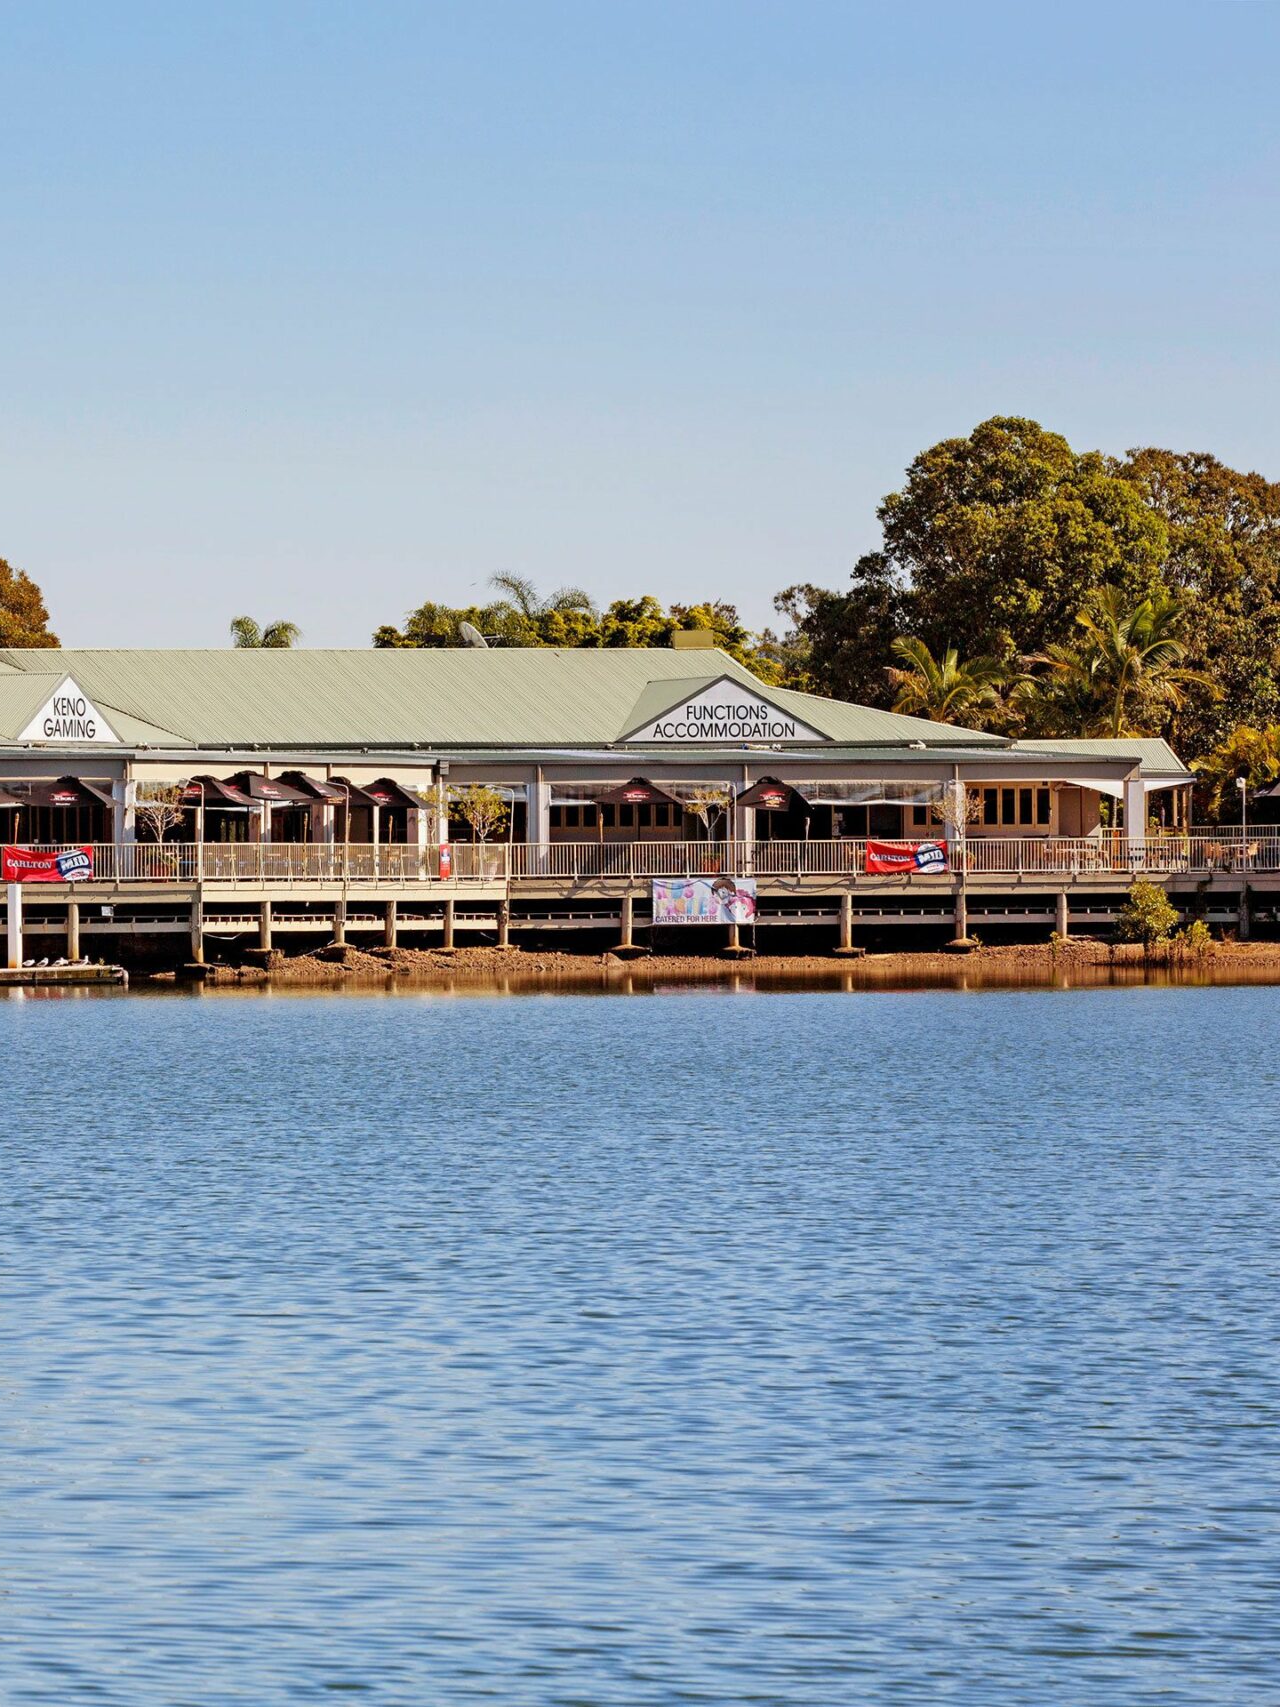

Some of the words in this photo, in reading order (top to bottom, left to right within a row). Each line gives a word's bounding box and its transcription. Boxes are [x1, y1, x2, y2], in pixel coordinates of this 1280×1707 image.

[53, 697, 86, 717] KENO
[686, 705, 768, 720] FUNCTIONS
[43, 718, 96, 739] GAMING
[652, 722, 795, 738] ACCOMMODATION
[6, 858, 52, 869] CARLTON
[60, 854, 89, 870] MID
[655, 915, 684, 925] CATERED
[686, 915, 700, 924] FOR
[701, 915, 718, 924] HERE
